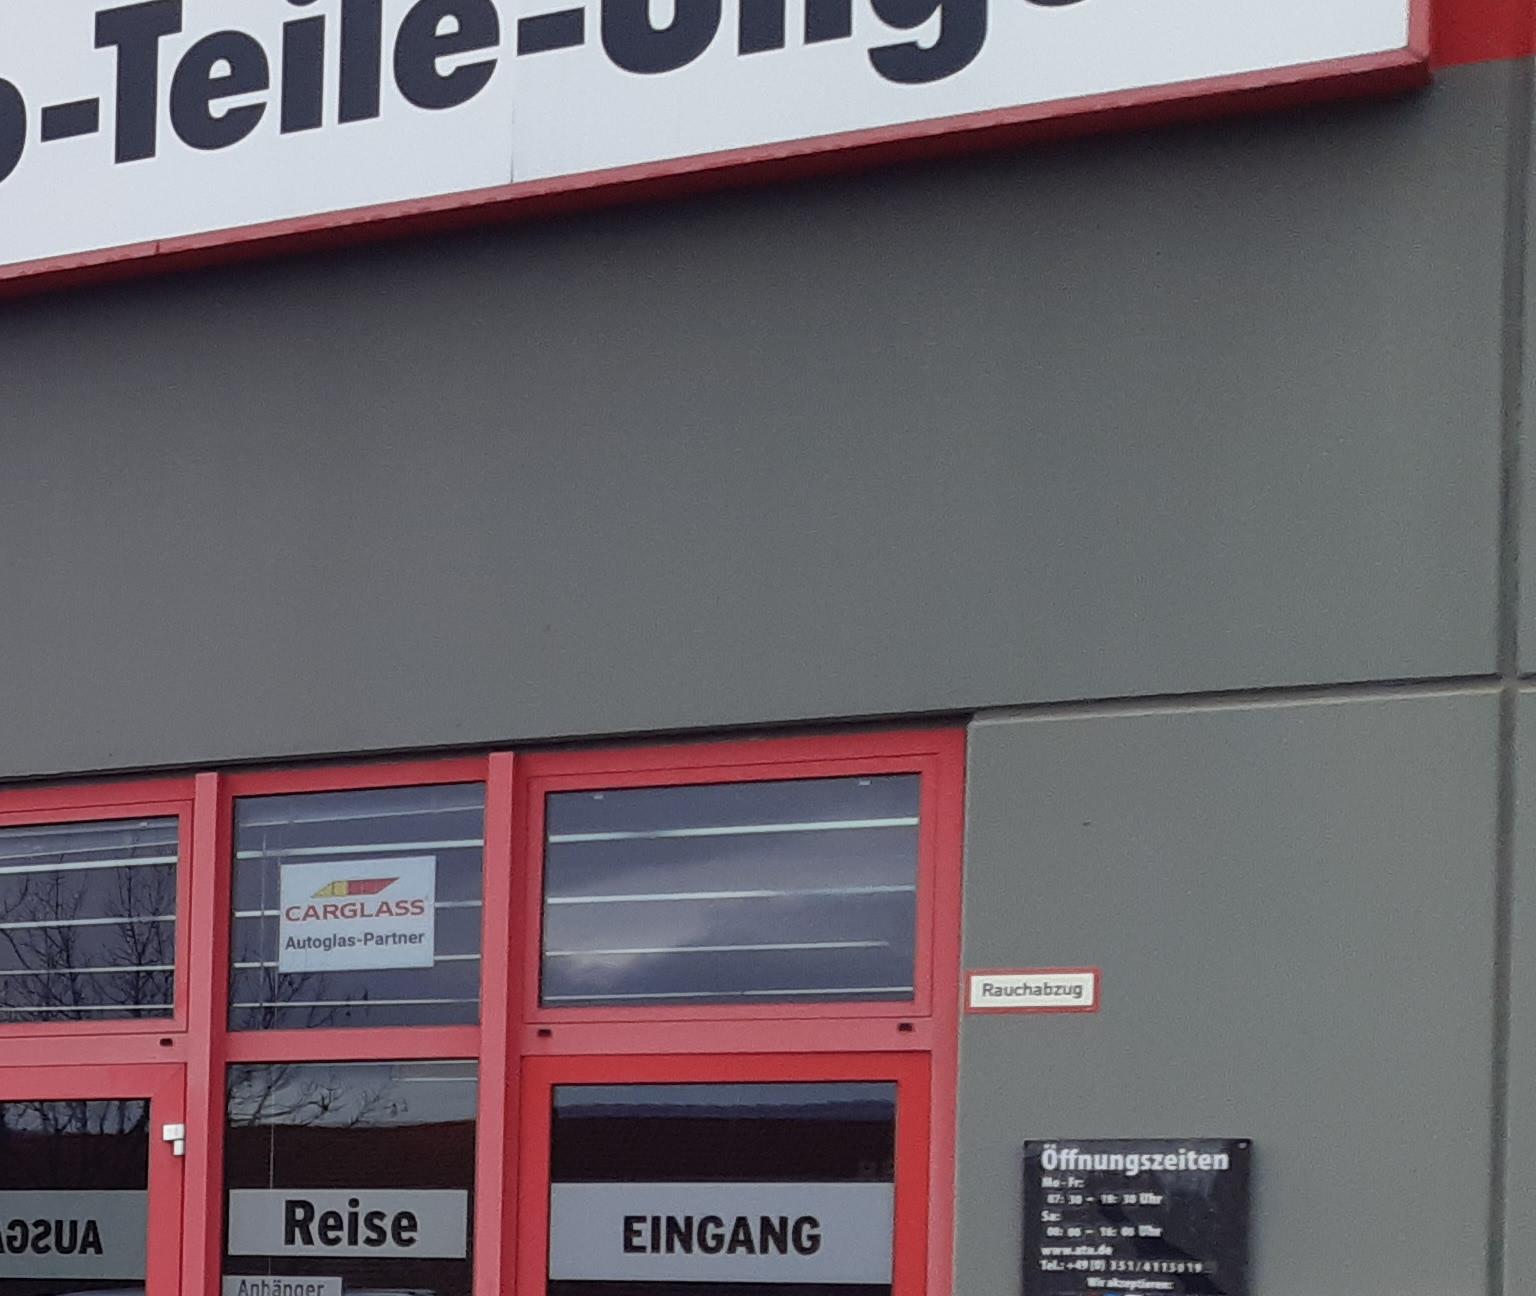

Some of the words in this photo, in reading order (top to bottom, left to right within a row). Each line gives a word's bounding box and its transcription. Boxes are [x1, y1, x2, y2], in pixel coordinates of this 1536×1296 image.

[285, 899, 425, 922] CARGLASS
[285, 932, 425, 951] Autoglas-Partner
[982, 982, 1083, 999] Rauchabzug
[1041, 1143, 1229, 1176] Öffnungszeiten
[284, 1198, 418, 1247] Reise
[623, 1215, 821, 1256] EINGANG
